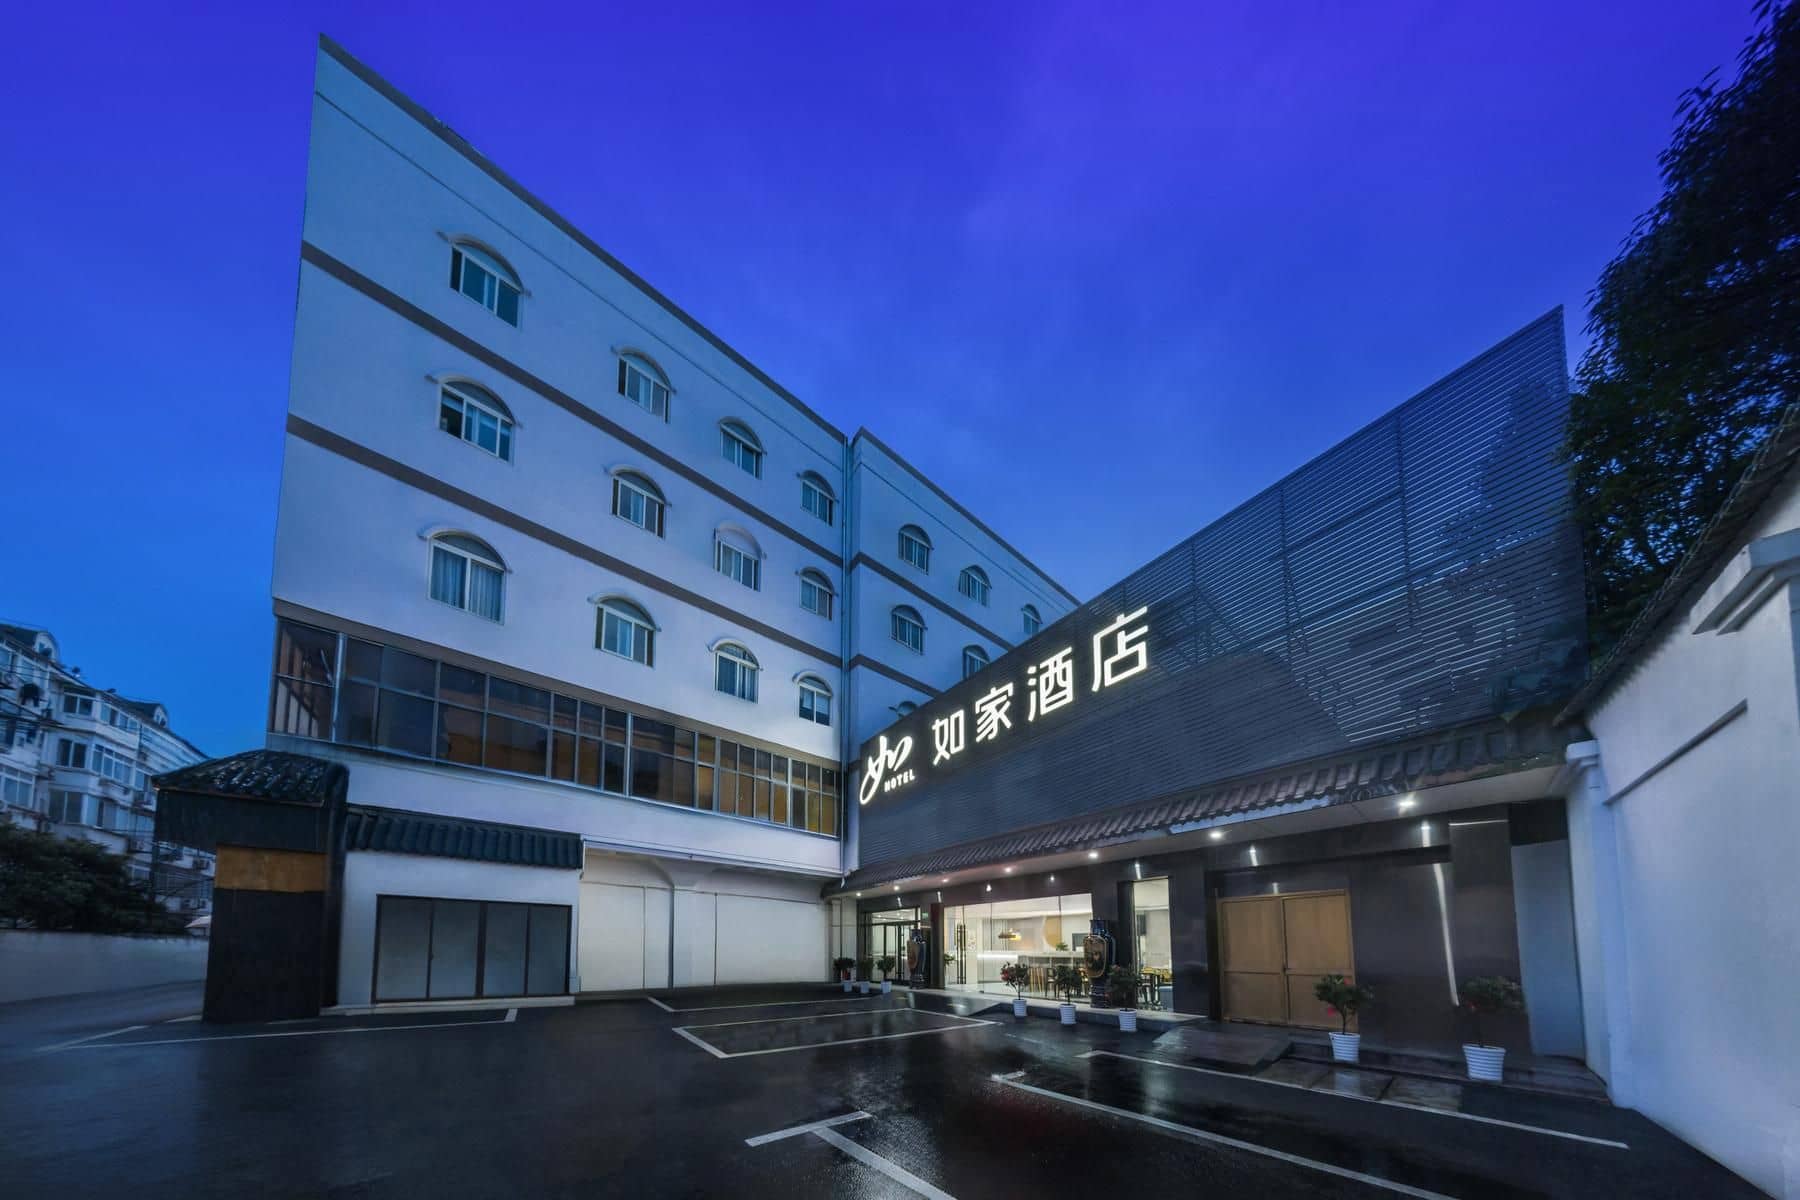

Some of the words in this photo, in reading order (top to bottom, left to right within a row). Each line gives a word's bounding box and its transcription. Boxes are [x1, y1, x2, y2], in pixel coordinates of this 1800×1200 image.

[931, 606, 1149, 766] 如家酒店
[884, 769, 915, 792] HOTEL
